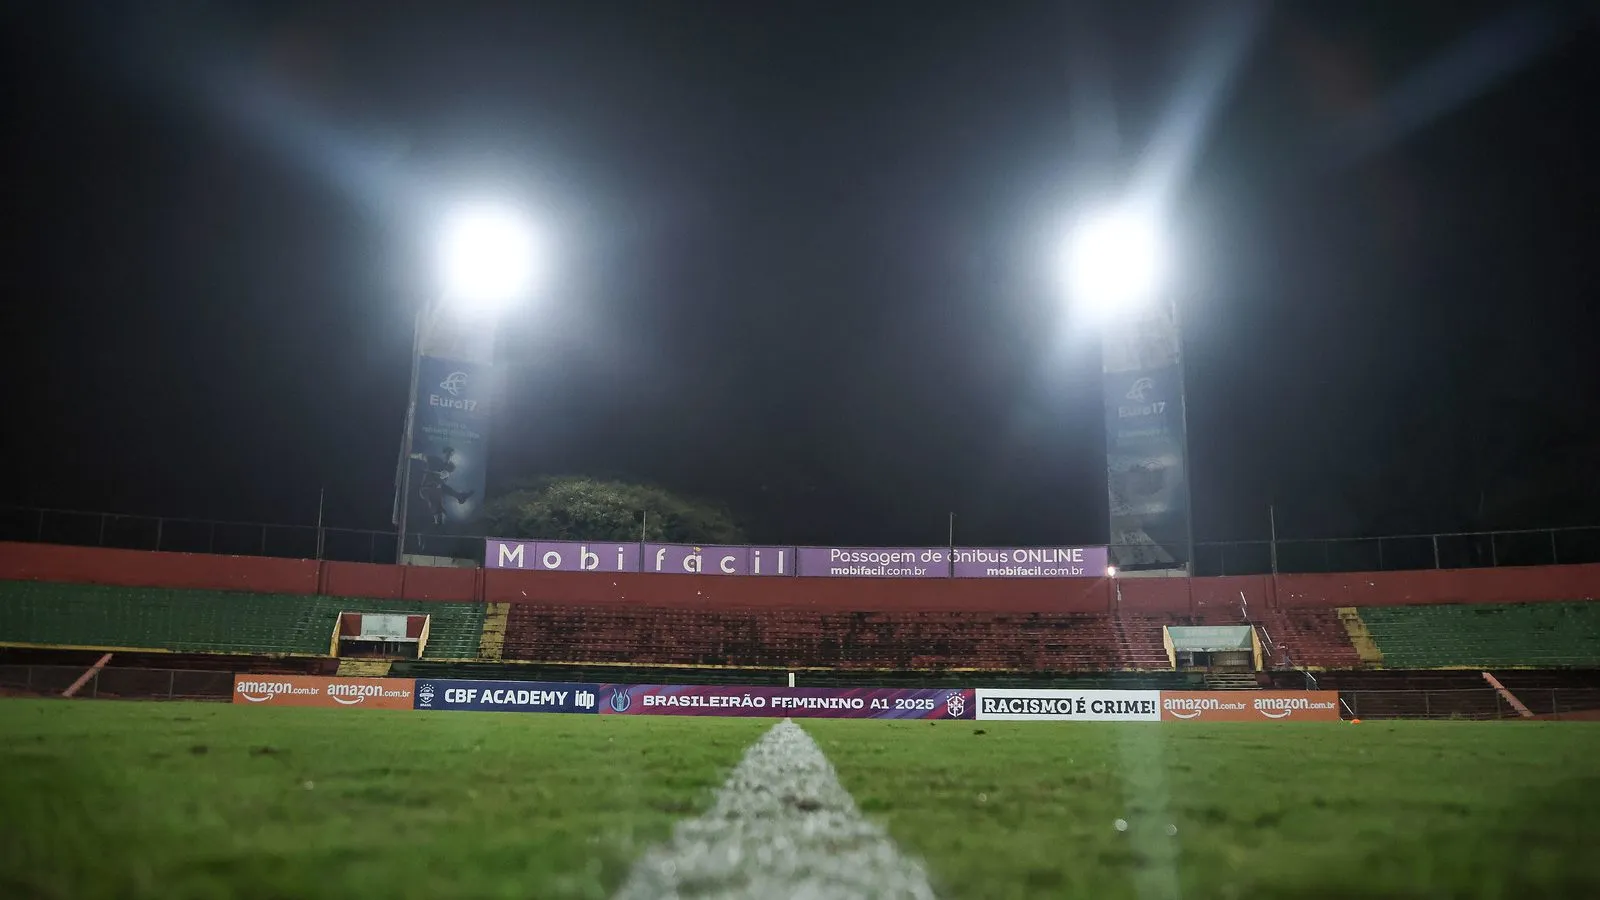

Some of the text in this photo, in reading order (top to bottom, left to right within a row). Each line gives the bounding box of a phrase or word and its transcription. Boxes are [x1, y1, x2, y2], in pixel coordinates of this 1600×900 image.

[429, 394, 478, 411] Euro17
[830, 548, 1084, 565] Passagem de ônibus ONLINE
[830, 565, 927, 577] mobifacil.com.br
[986, 565, 1084, 577] mobifacil.com.br
[236, 681, 320, 695] amazon.com.br
[327, 683, 411, 698] amazon.com.br
[444, 688, 569, 706] CBF ACADEMY
[574, 690, 595, 710] idp
[643, 693, 935, 710] BRASILEIRÃO FEMININO A1 2025
[983, 696, 1156, 714] RACISMO É CRIME!
[1163, 697, 1247, 711] amazon.com.br
[1253, 697, 1336, 711] amazon.com.br
